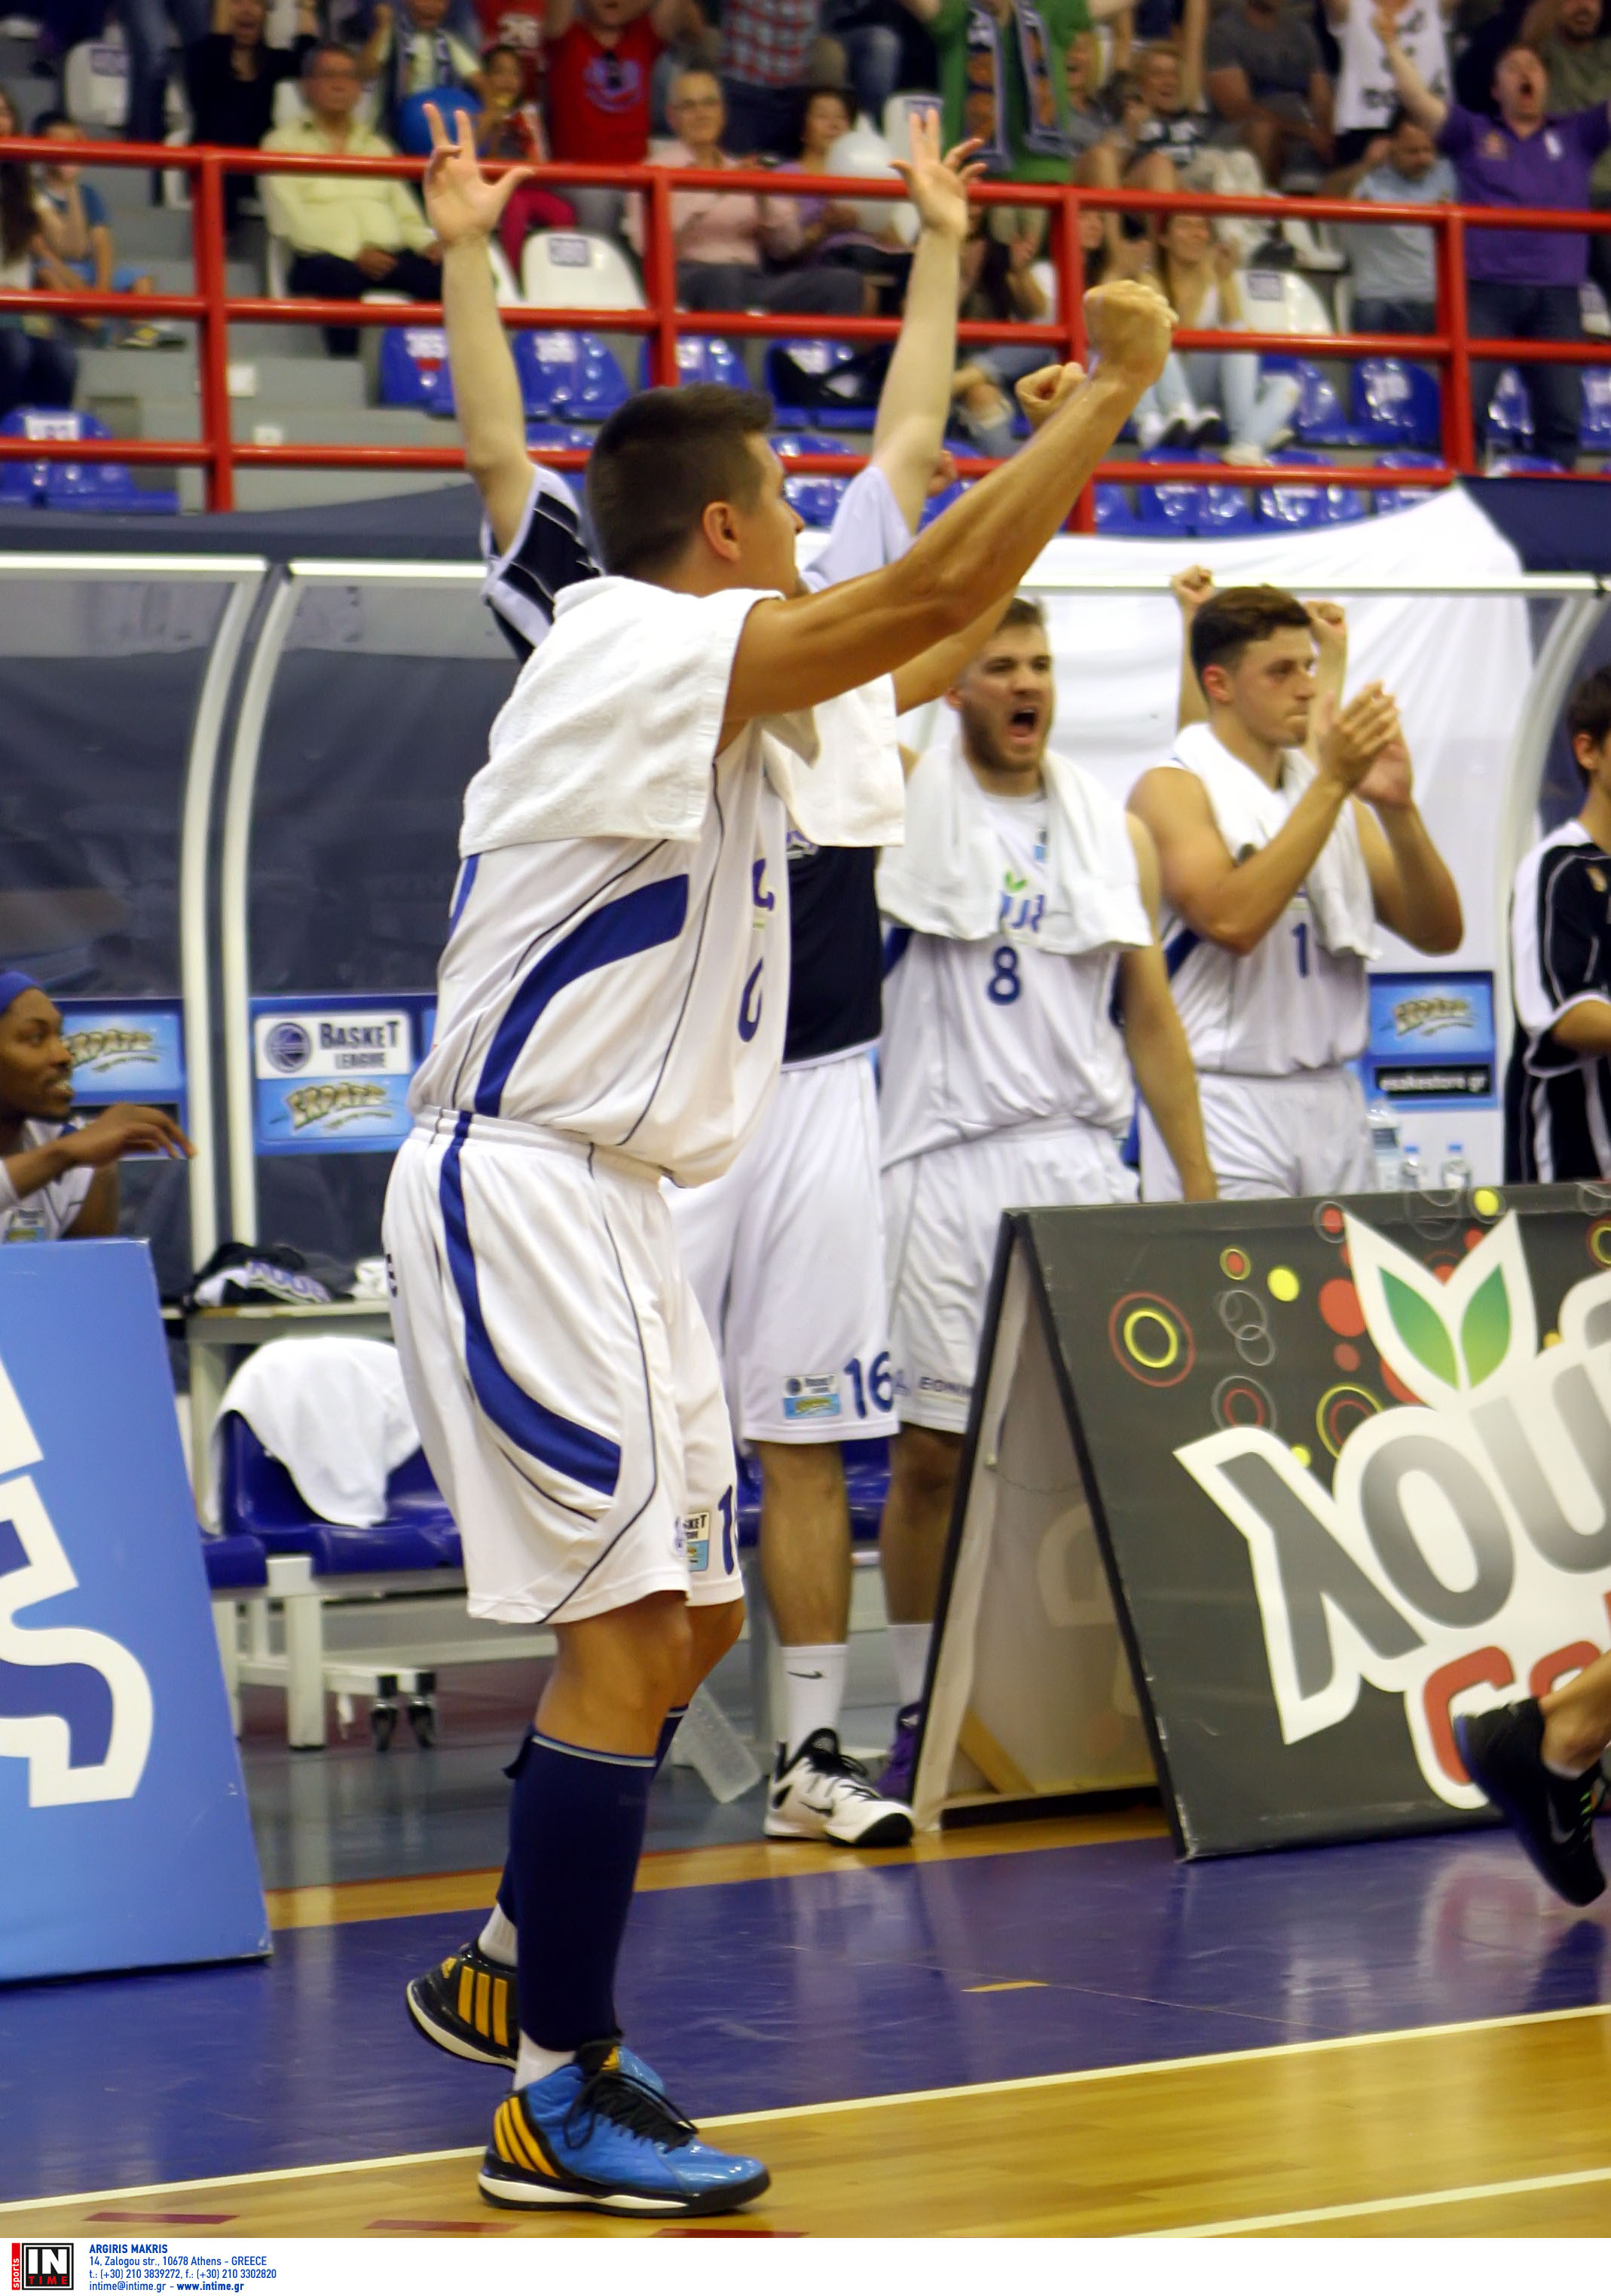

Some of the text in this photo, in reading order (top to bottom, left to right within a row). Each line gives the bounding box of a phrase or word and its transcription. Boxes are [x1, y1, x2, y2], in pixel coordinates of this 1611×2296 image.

[988, 946, 1021, 1005] 8
[1292, 922, 1308, 978] 1
[843, 1351, 894, 1420] 16
